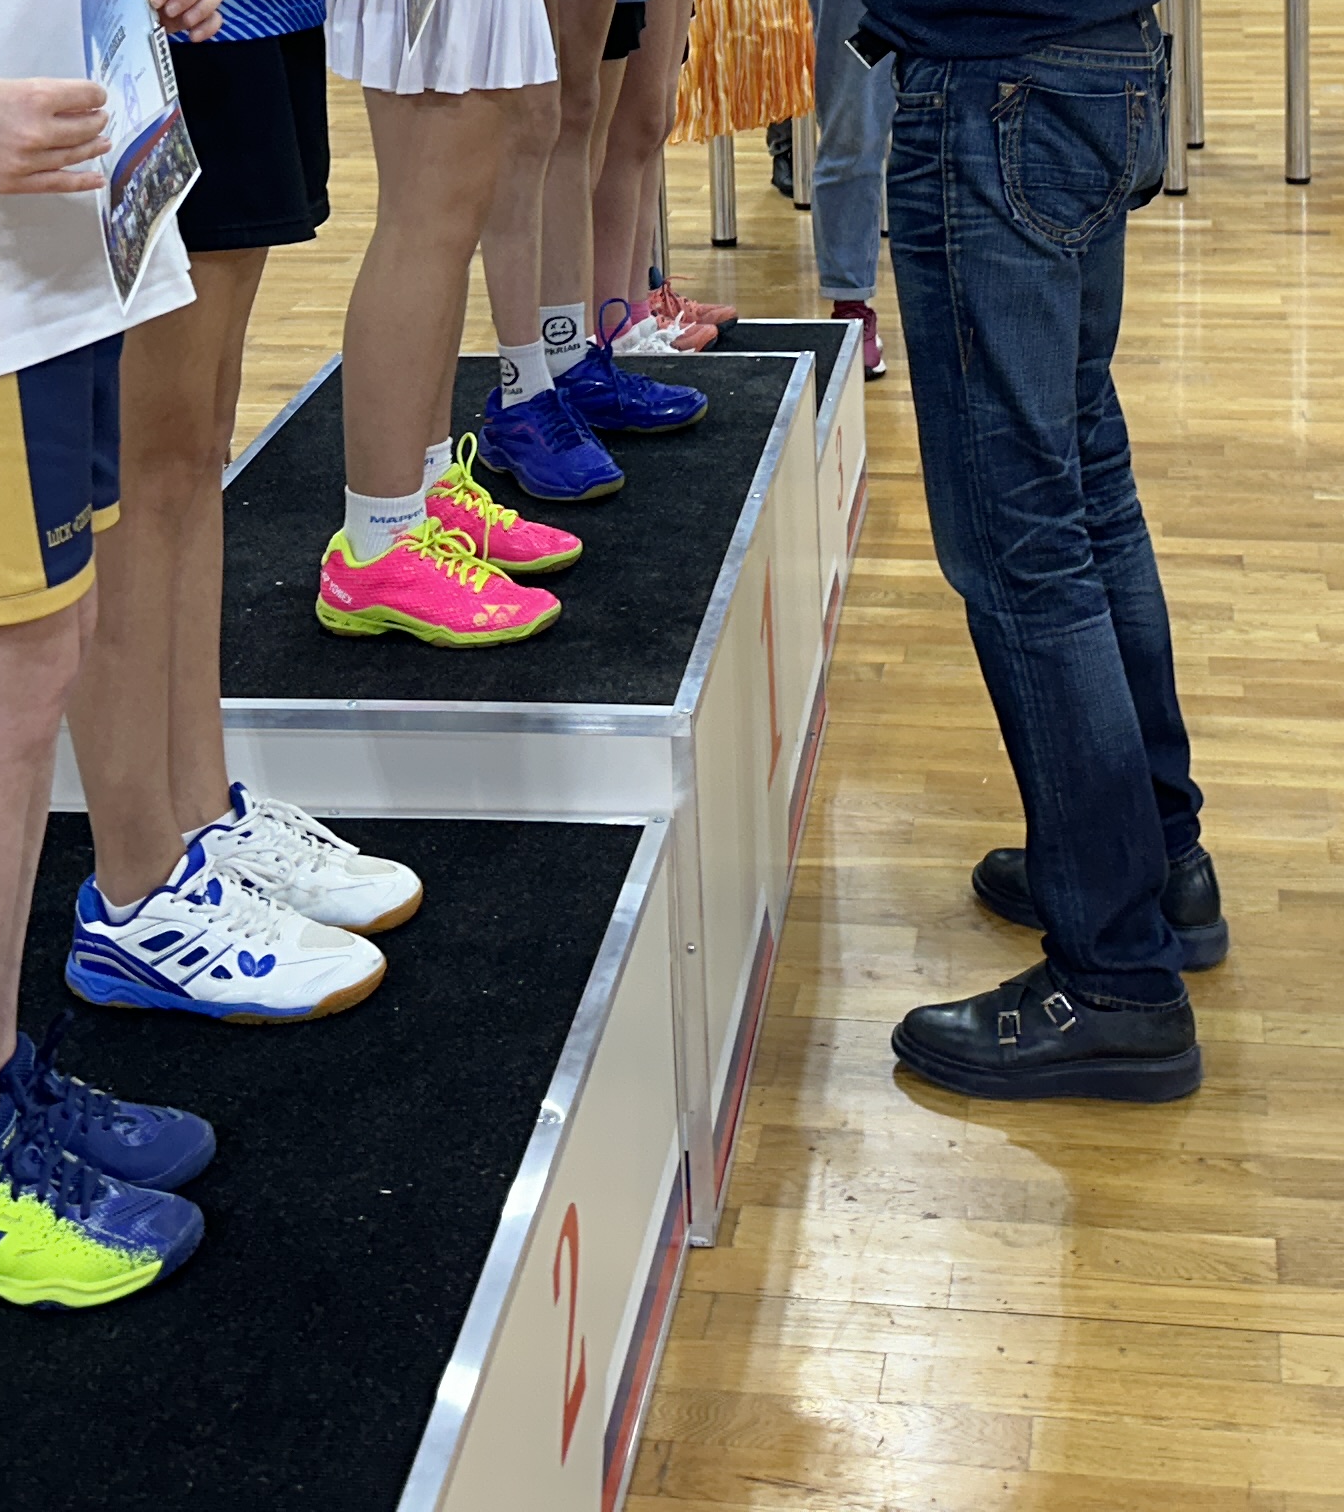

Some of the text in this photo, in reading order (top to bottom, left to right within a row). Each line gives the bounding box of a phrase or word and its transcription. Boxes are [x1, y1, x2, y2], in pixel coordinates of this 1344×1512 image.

[834, 424, 844, 512] 3
[759, 555, 783, 793] 1
[553, 1202, 586, 1468] 2
